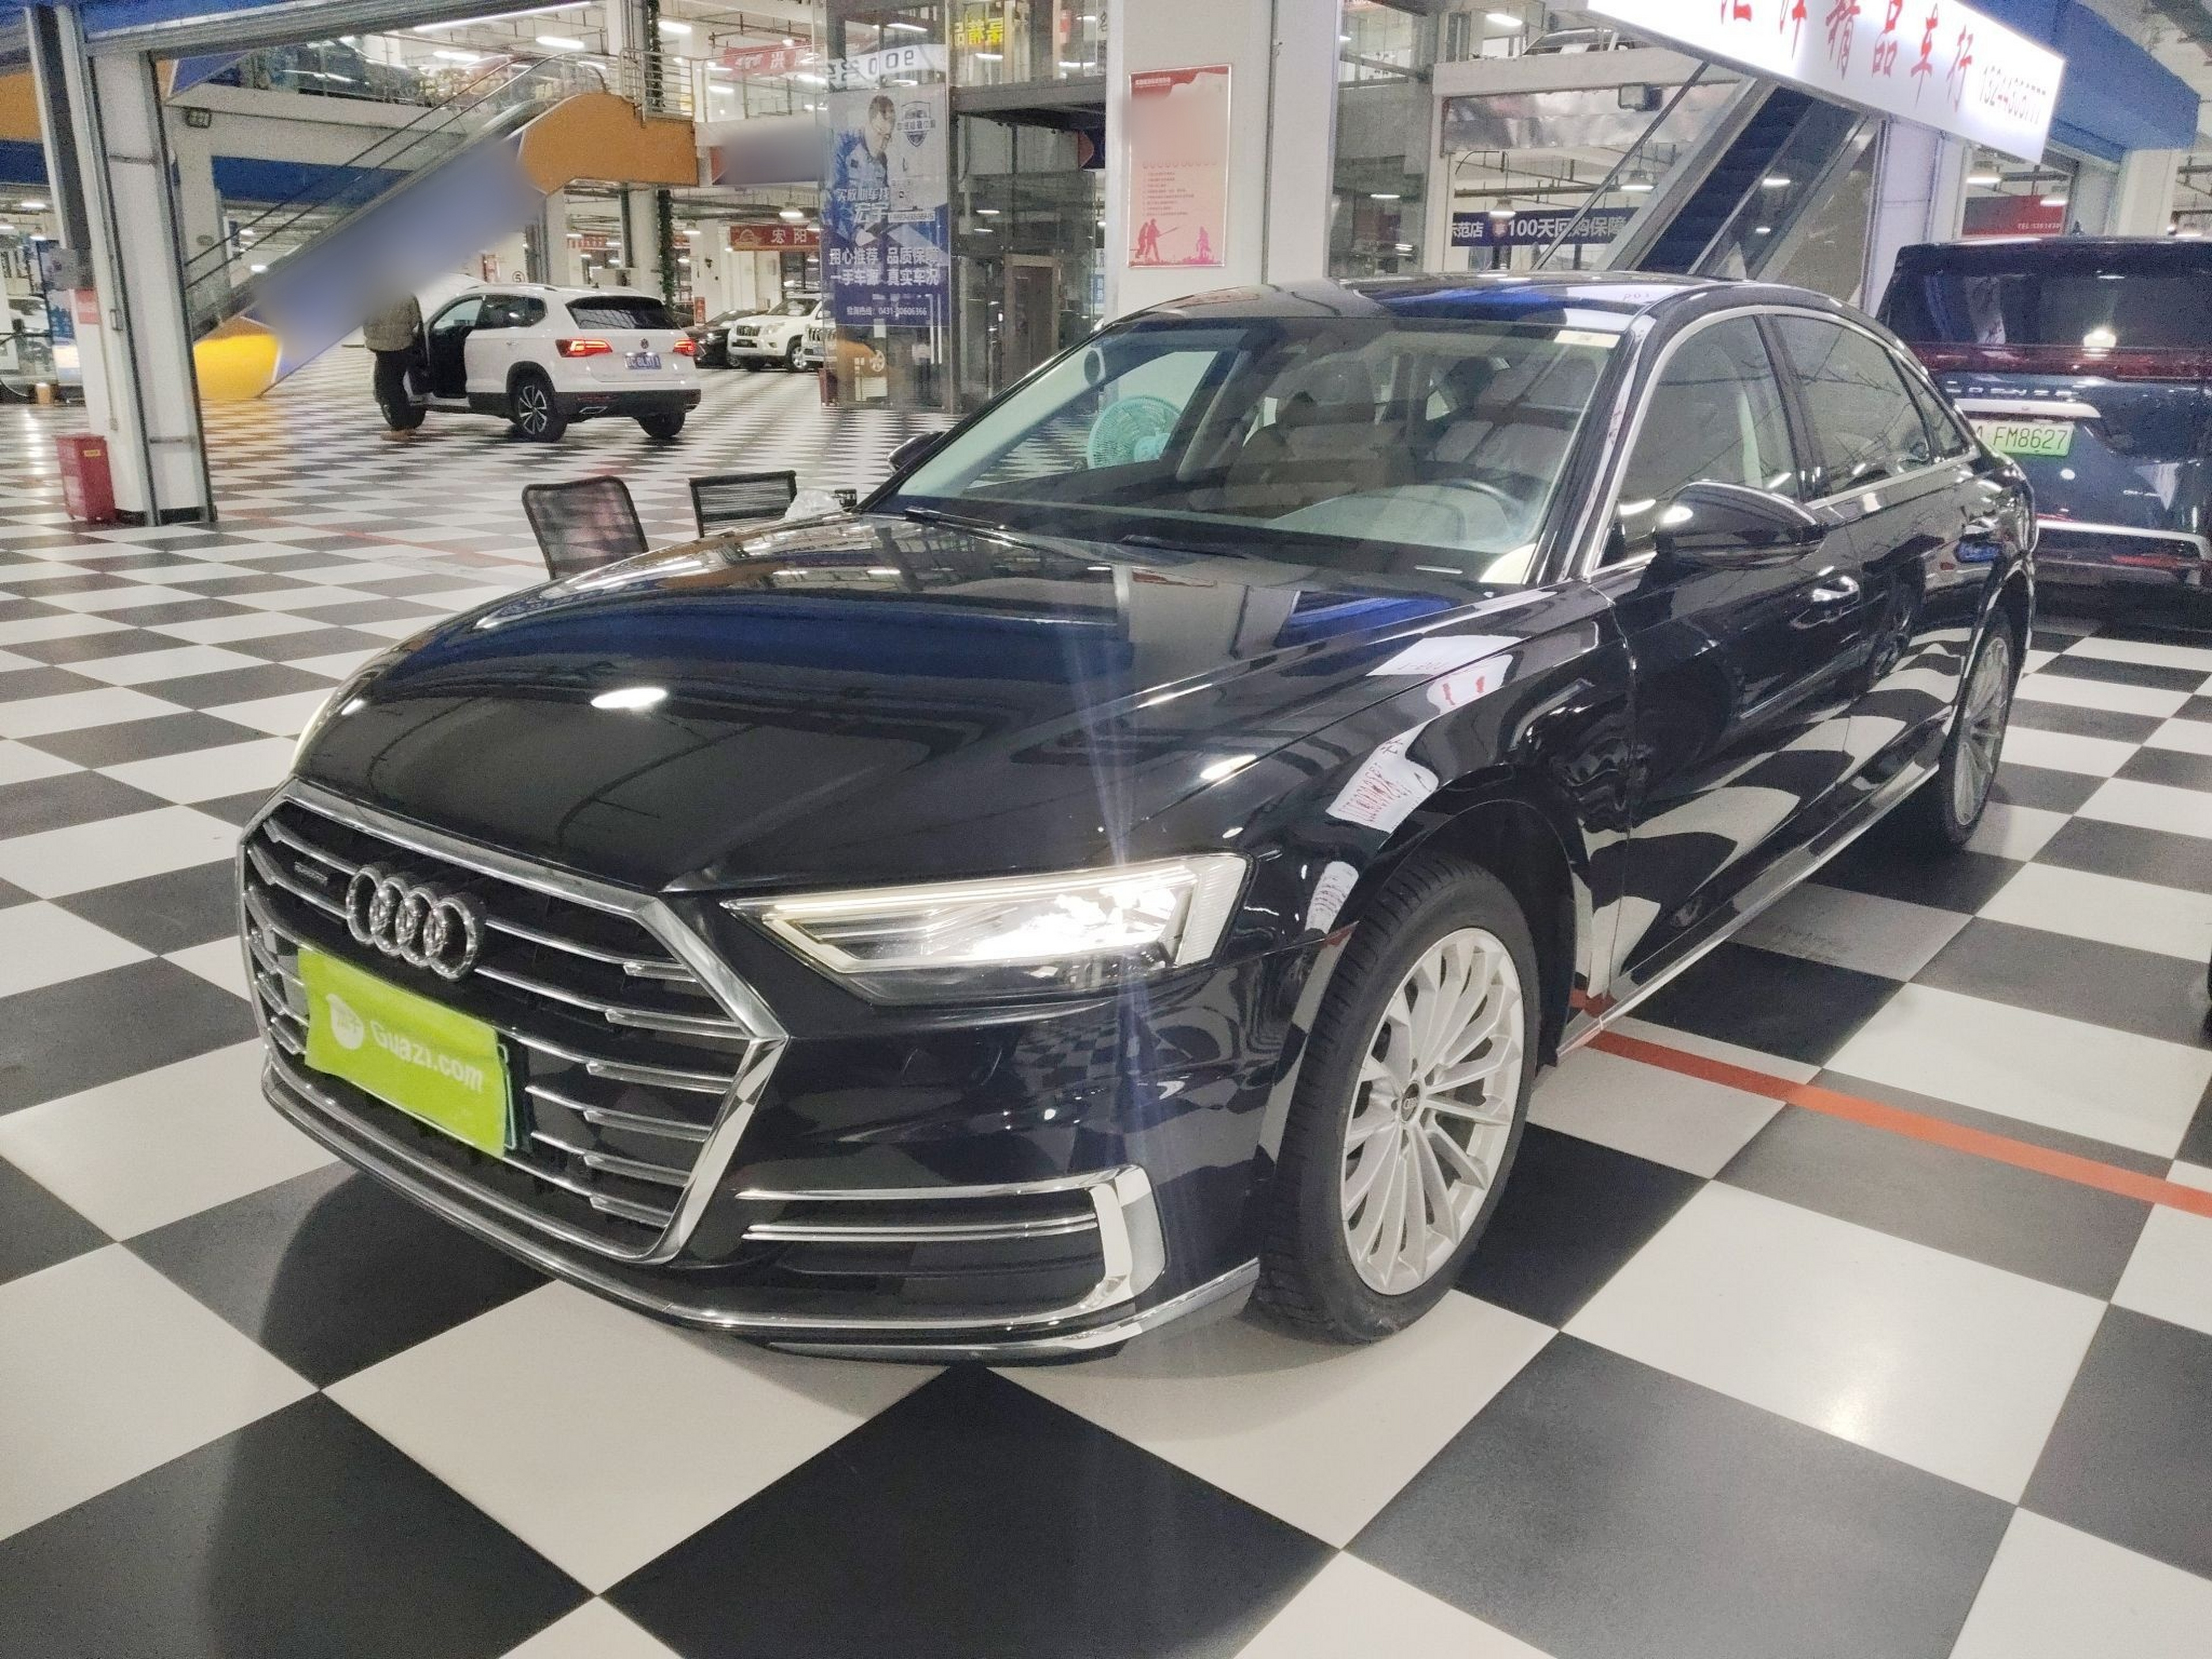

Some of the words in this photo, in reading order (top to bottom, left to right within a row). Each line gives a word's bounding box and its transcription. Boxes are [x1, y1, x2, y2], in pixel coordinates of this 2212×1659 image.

[887, 268, 940, 286] 真实车况
[1993, 426, 2068, 450] FM8627
[370, 1019, 483, 1093] Guazi.com
